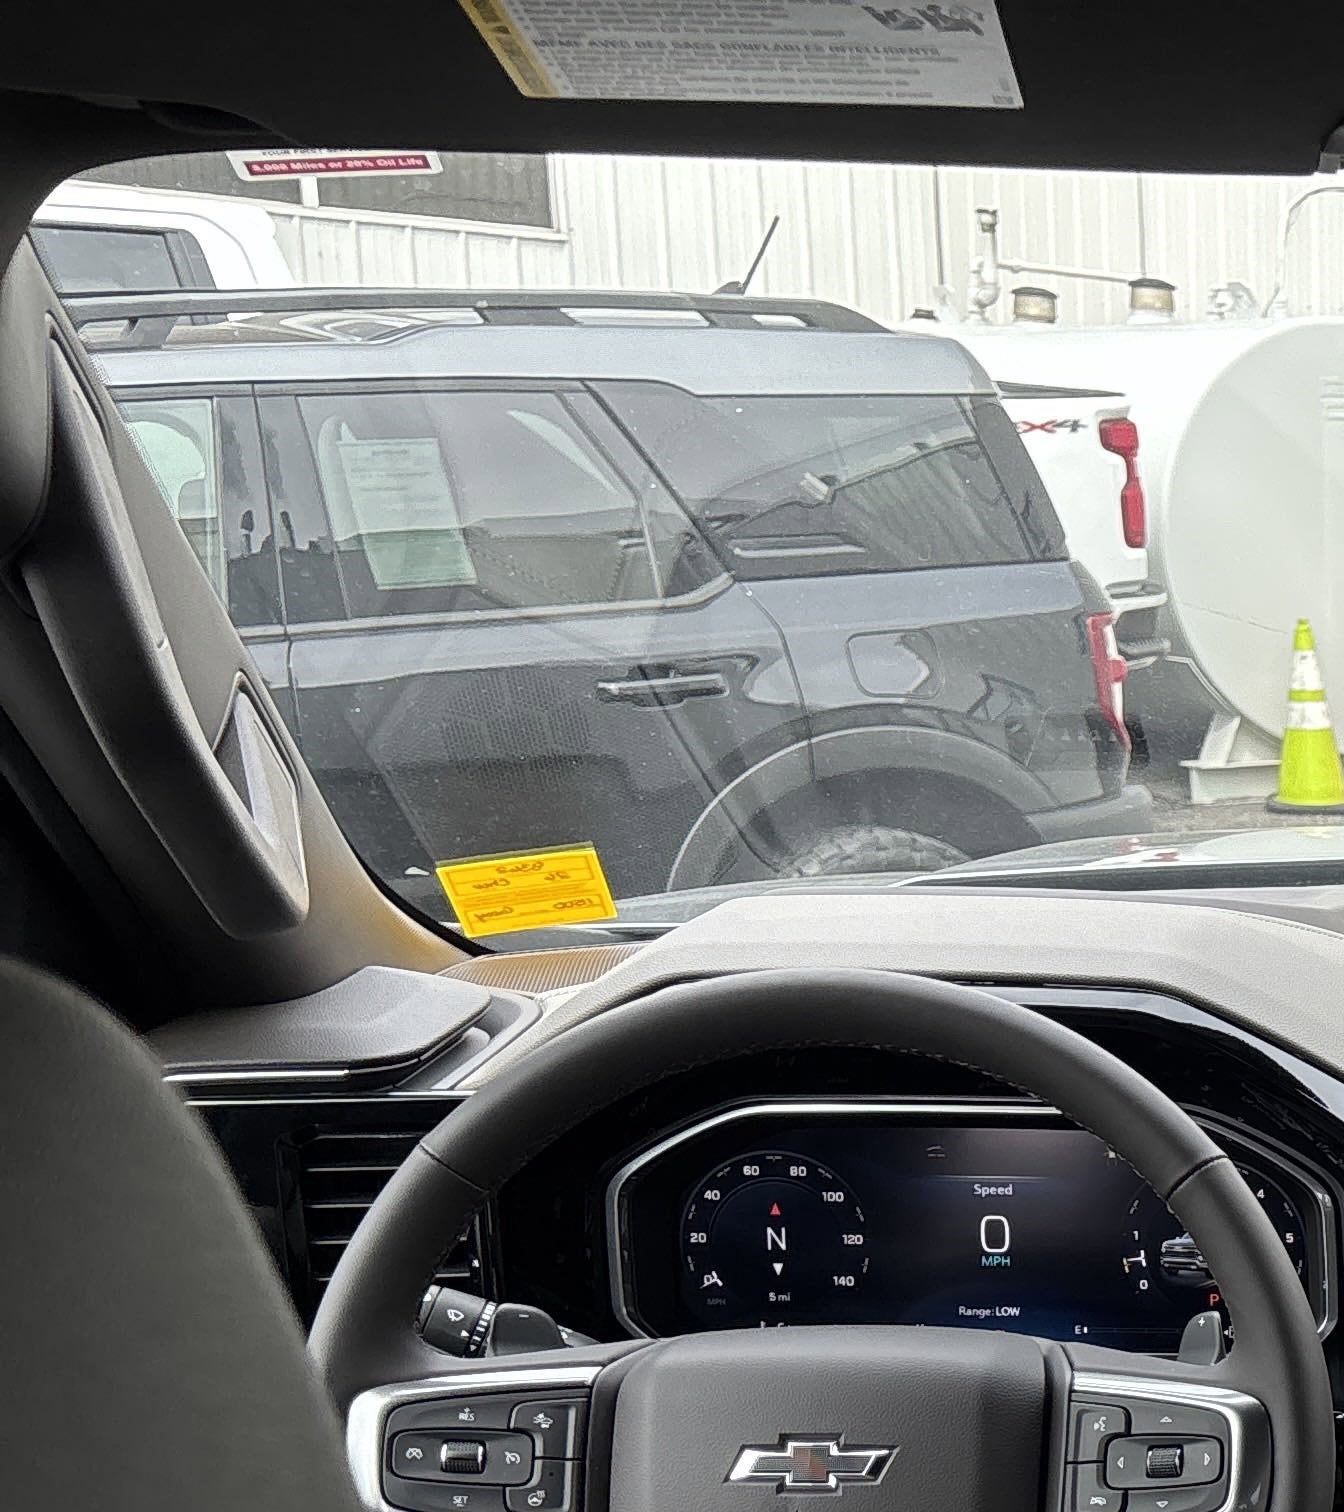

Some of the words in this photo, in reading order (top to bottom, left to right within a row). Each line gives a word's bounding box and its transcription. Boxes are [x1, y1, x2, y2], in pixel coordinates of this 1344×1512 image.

[1015, 418, 1088, 434] X4
[743, 1165, 760, 1177] 60
[789, 1165, 807, 1177] 80
[703, 1189, 721, 1201] 40
[973, 1183, 1013, 1198] Speed
[1256, 1188, 1266, 1199] 4
[822, 1191, 844, 1203] 100
[689, 1232, 707, 1244] 20
[766, 1226, 788, 1252] N
[842, 1234, 864, 1245] 120
[980, 1214, 1011, 1254] 0
[1132, 1230, 1139, 1241] 1
[1285, 1232, 1294, 1243] 5
[981, 1255, 1011, 1268] MPH
[832, 1275, 855, 1287] 140
[1139, 1279, 1149, 1290] 0
[777, 1292, 791, 1302] mi
[1209, 1293, 1220, 1307] P
[958, 1306, 995, 1320] Range:
[995, 1306, 1021, 1317] LOW
[1074, 1325, 1082, 1335] E
[458, 1412, 475, 1421] RES
[452, 1495, 469, 1505] SET
